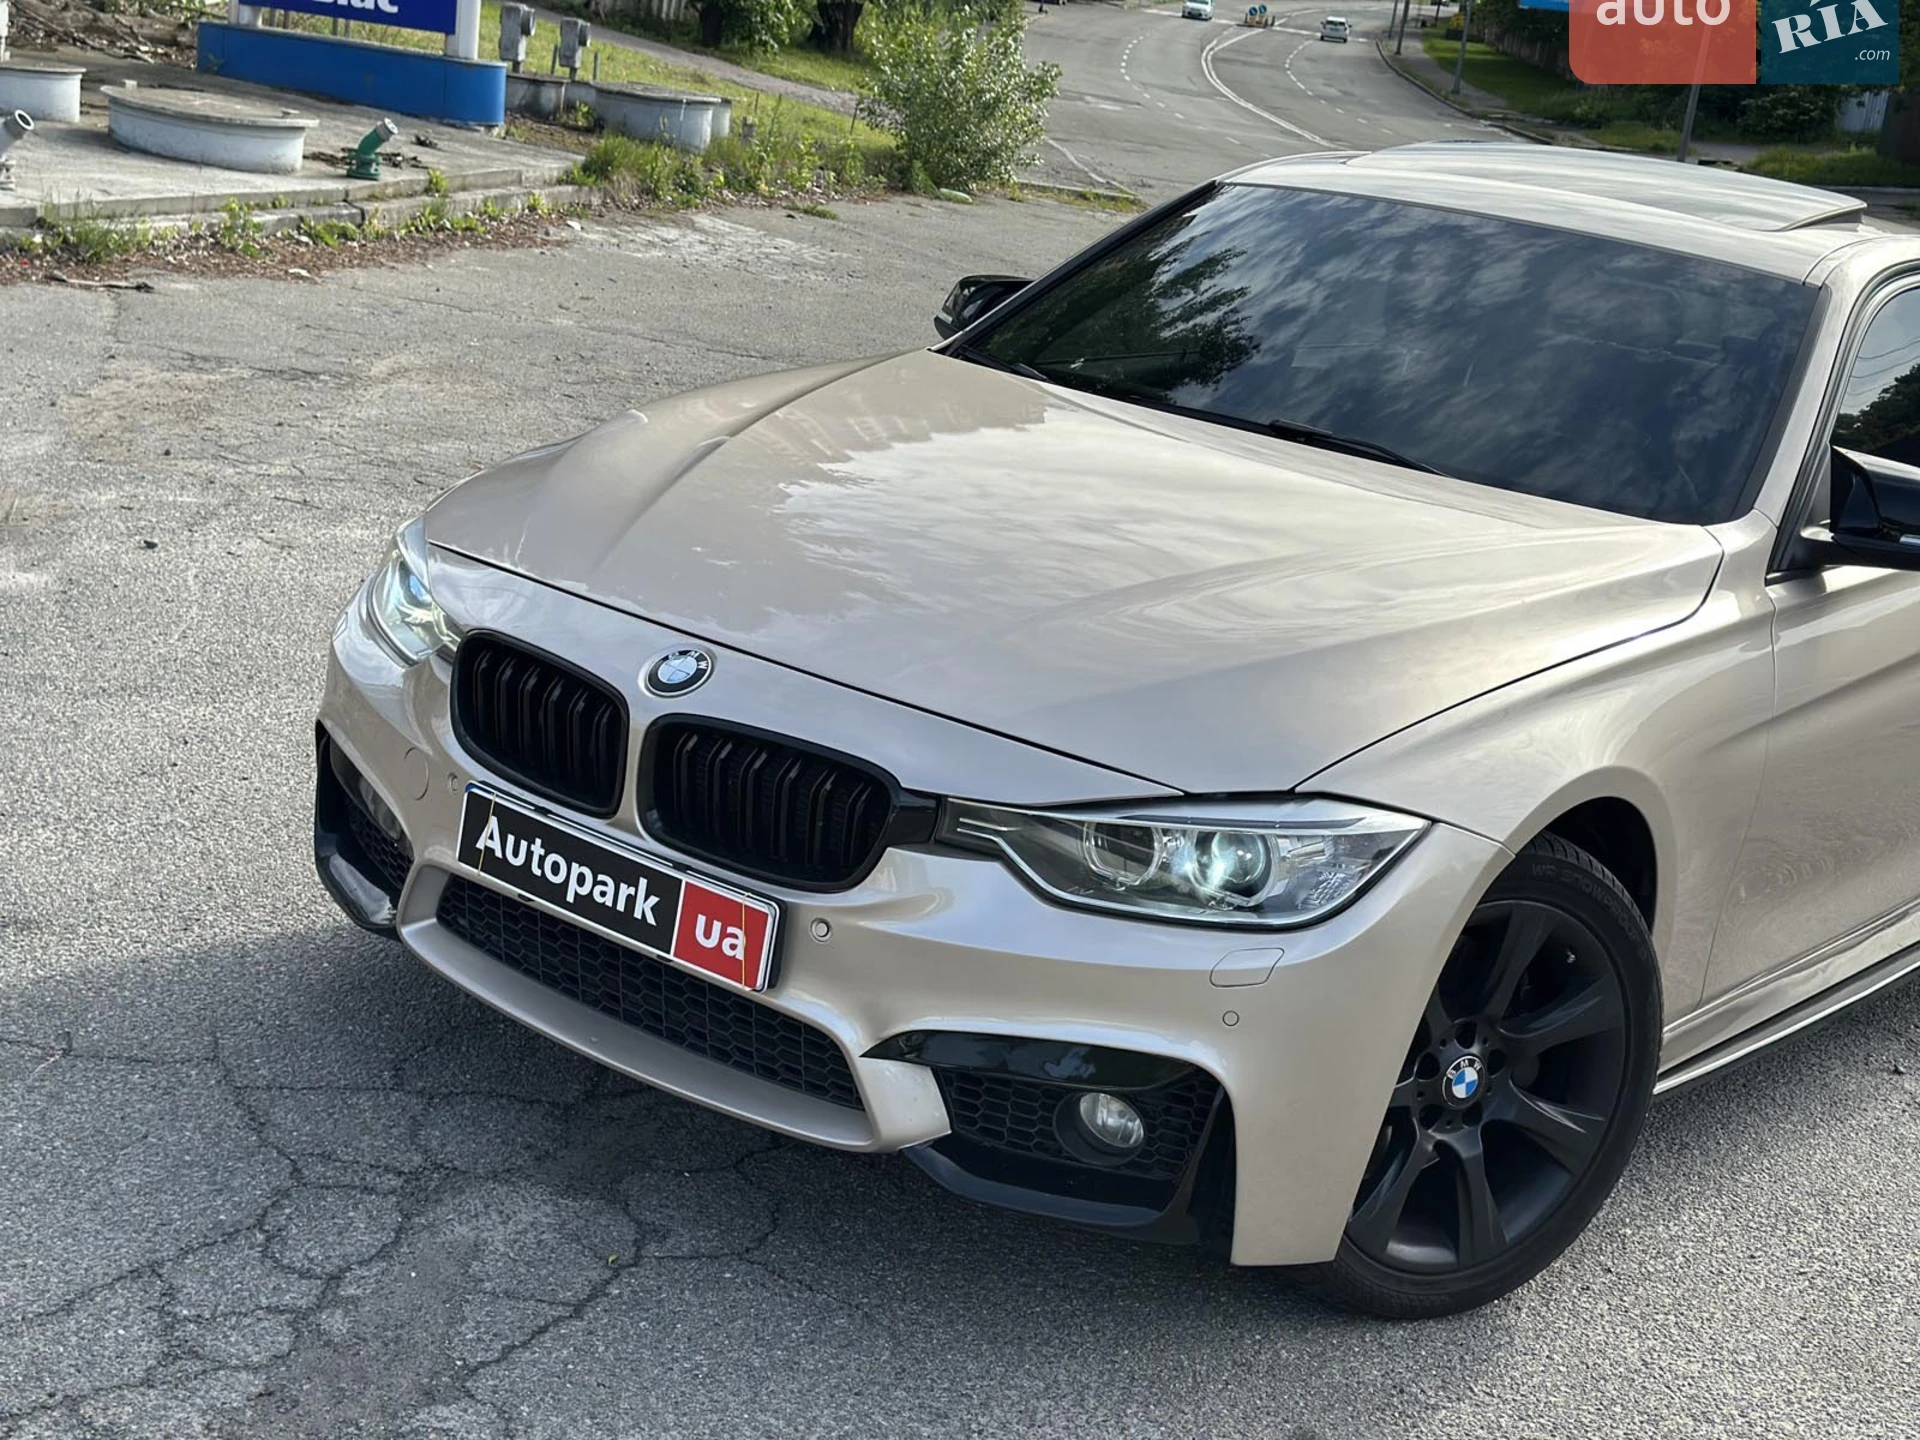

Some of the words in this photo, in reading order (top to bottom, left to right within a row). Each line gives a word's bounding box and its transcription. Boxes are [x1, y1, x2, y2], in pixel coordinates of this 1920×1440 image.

[476, 816, 661, 926] Autopark
[695, 914, 746, 960] ua
[1447, 1059, 1482, 1080] BMW
